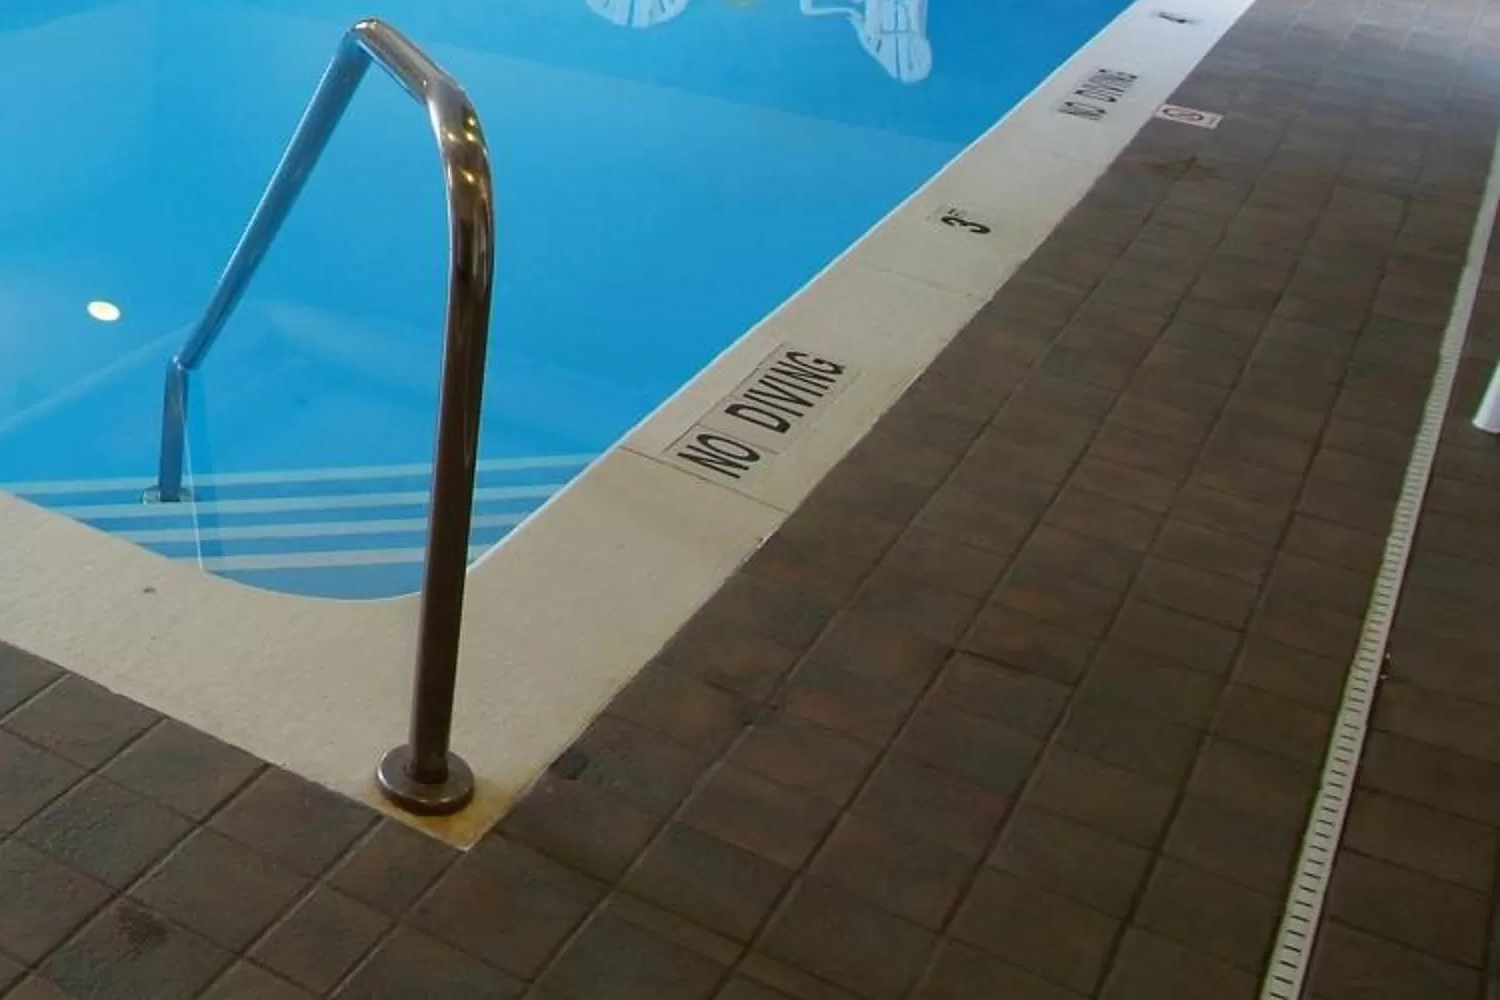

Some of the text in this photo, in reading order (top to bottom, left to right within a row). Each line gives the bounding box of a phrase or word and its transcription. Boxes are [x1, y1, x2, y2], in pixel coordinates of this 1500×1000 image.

[941, 216, 991, 235] 3
[676, 351, 847, 479] NO DIVING
